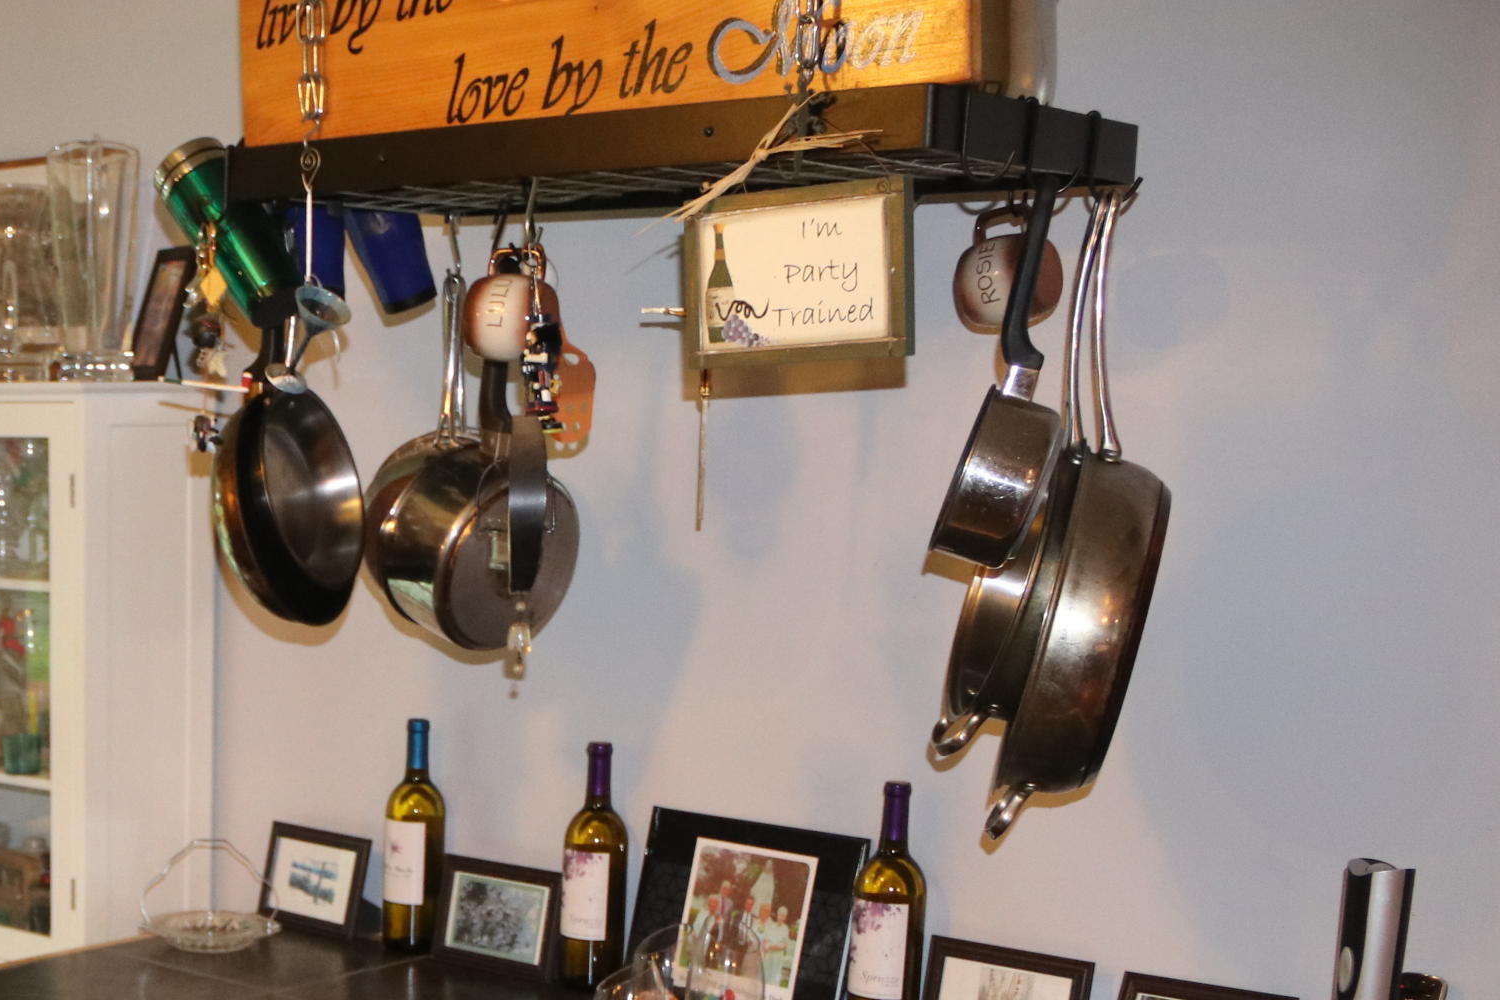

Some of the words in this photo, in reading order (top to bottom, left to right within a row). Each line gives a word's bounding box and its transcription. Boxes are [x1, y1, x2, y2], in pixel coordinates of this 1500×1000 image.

[257, 0, 314, 50] liv
[447, 53, 530, 124] love
[541, 35, 603, 116] by
[619, 18, 693, 99] the
[802, 218, 842, 238] I'm
[784, 260, 859, 292] Party
[977, 241, 1001, 305] ROSIE
[772, 298, 874, 327] Trained
